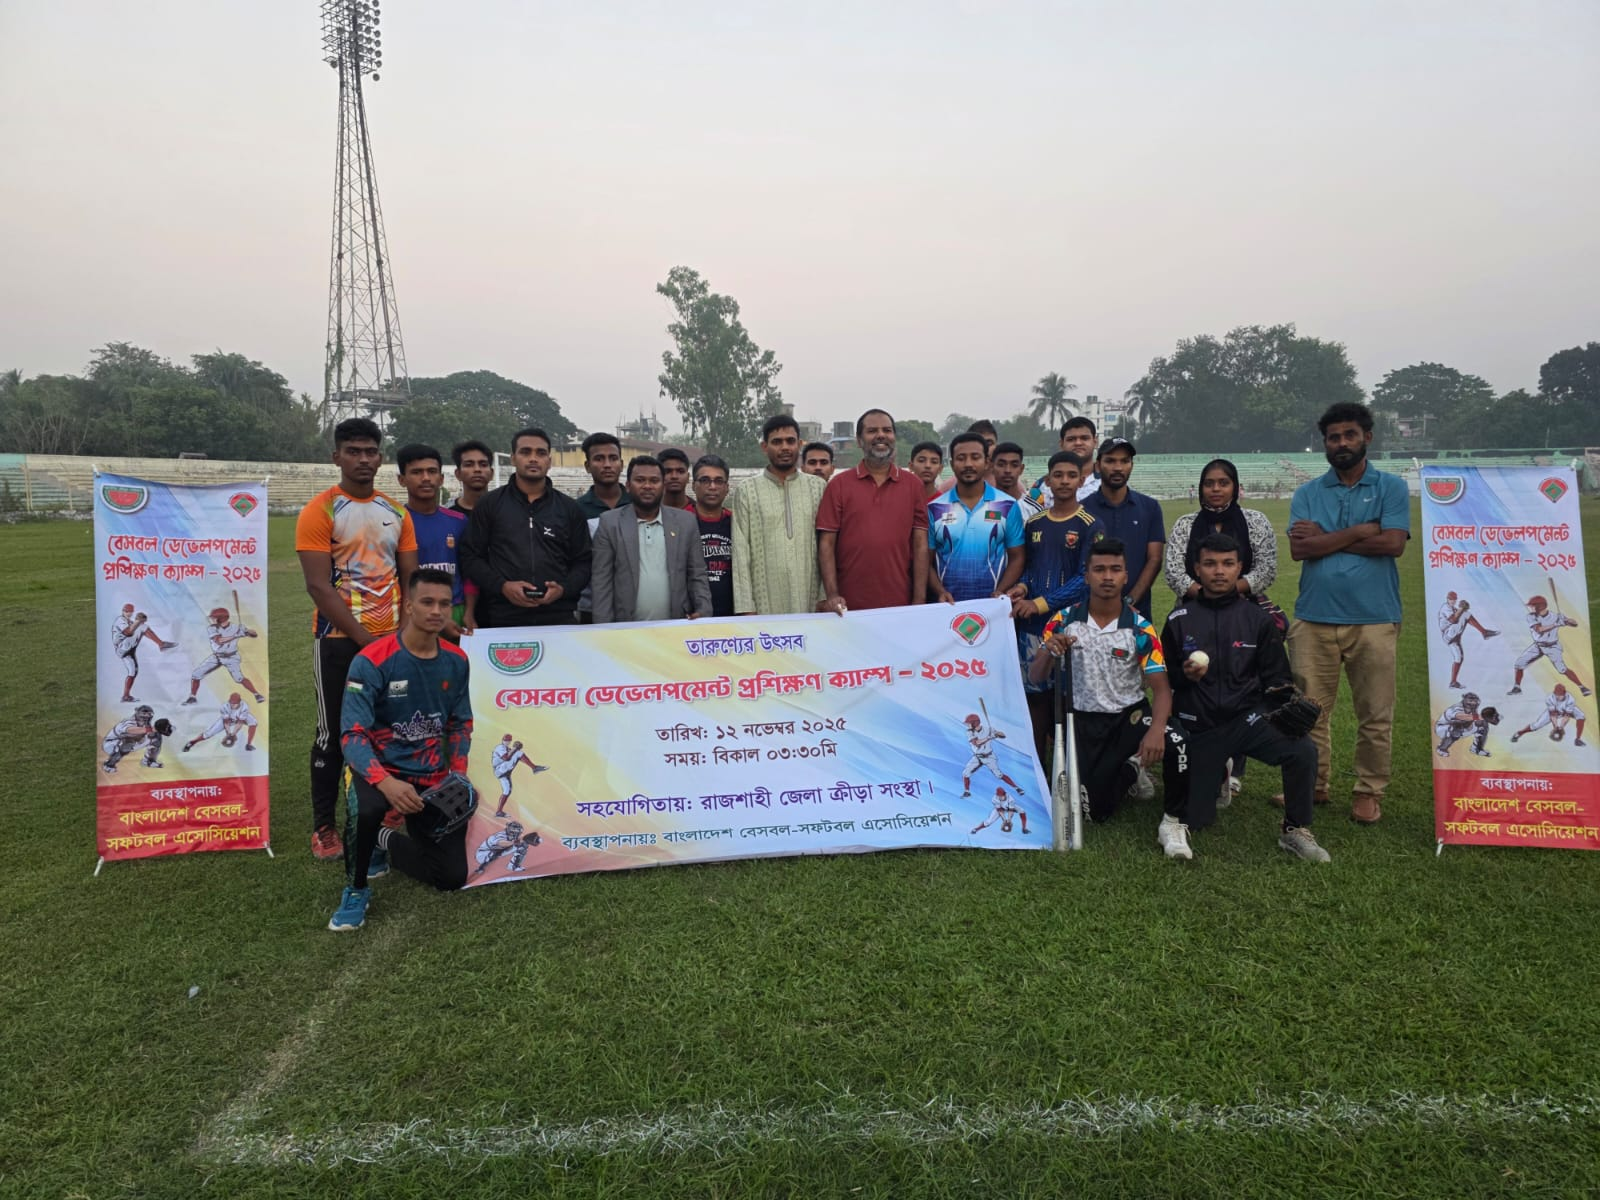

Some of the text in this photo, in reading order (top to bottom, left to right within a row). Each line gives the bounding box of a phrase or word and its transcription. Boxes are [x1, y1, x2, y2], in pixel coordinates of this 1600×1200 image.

[108, 535, 257, 558] বেসবল ডেভেলপমেন্ট
[1432, 524, 1570, 545] বেসবল ডেভেলপমেন্ট
[103, 556, 159, 580] প্রশিক্ষণ
[163, 564, 204, 582] ক্যাম্প
[222, 566, 261, 583] ২০২৫
[1428, 546, 1478, 569] প্রশিক্ষণ
[1482, 551, 1520, 569] ক্যাম্প
[1537, 553, 1577, 571] ২০২৫
[685, 631, 804, 657] তারুণ্যের উৎসব
[495, 687, 577, 709] বেসবল
[584, 675, 732, 708] ডেভেলপমেন্ট
[737, 669, 821, 700] প্রশিক্ষণ
[828, 665, 892, 689] ক্যাম্প
[920, 658, 988, 682] ২০২৫
[655, 717, 847, 743] তারিখ: ১২ নভেম্বর ২০২৫
[664, 738, 838, 768] সময়: বিকাল ০৩:৩০মি
[1176, 743, 1188, 773] VDP
[576, 793, 693, 818] সহযোগিতায়:
[700, 786, 772, 811] রাজশাহী
[779, 785, 823, 805] জেলা
[829, 780, 874, 807] ক্রীড়া
[879, 778, 924, 799] সংস্থা
[1453, 796, 1585, 815] বাংলাদেশ বেসবল-
[118, 803, 248, 826] বাংলাদেশ বেসবল-
[663, 827, 734, 844] বাংলাদেশ
[739, 819, 855, 838] বেসবল-সফটবল
[861, 811, 953, 832] এসোসিয়েশন
[105, 825, 262, 852] সফটবল এসোসিয়েশন
[1444, 819, 1600, 841] সফটবল এসোসিয়েশন
